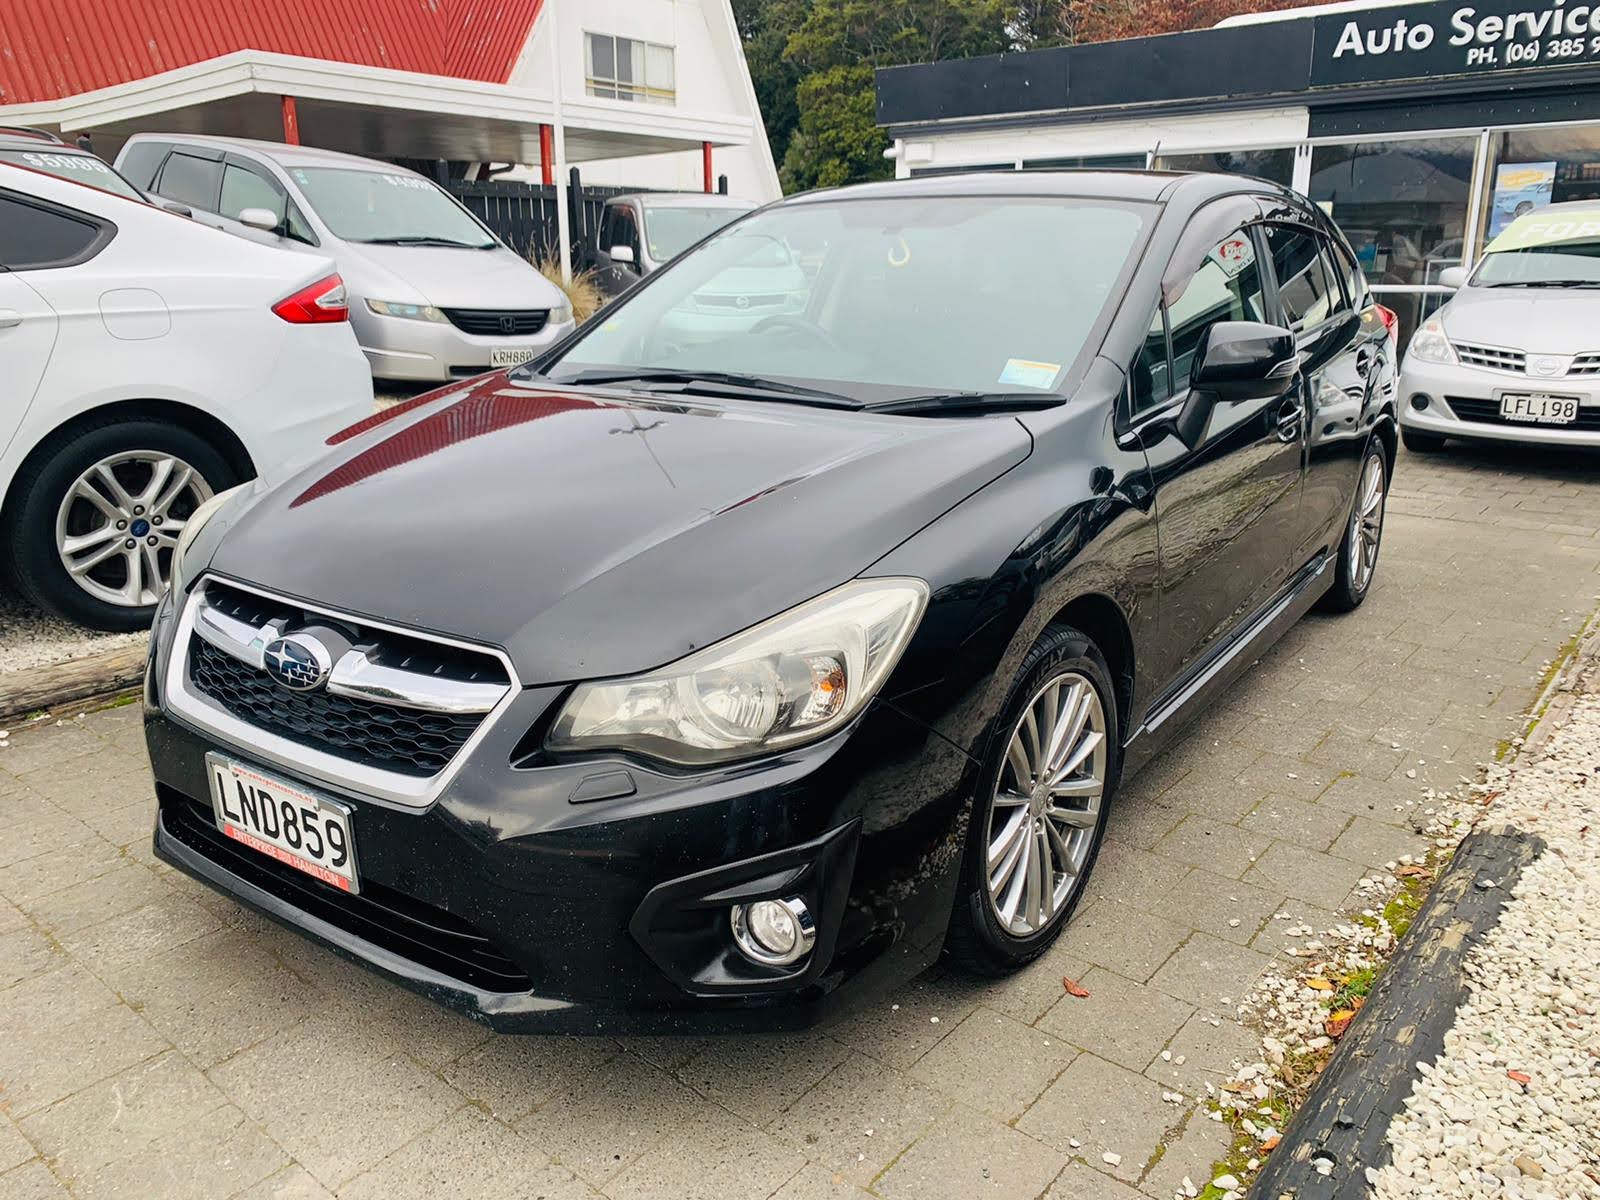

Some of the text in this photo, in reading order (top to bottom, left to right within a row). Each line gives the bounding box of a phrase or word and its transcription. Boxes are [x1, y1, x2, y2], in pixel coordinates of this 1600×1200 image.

[1332, 19, 1435, 59] Auto
[1466, 47, 1498, 66] PH.
[1505, 40, 1540, 64] (06)
[1547, 37, 1586, 58] 385
[1503, 398, 1574, 418] LFL198
[216, 771, 348, 868] LND859
[232, 828, 279, 857] ENTERPRISE
[294, 855, 340, 888] HAMILTON
